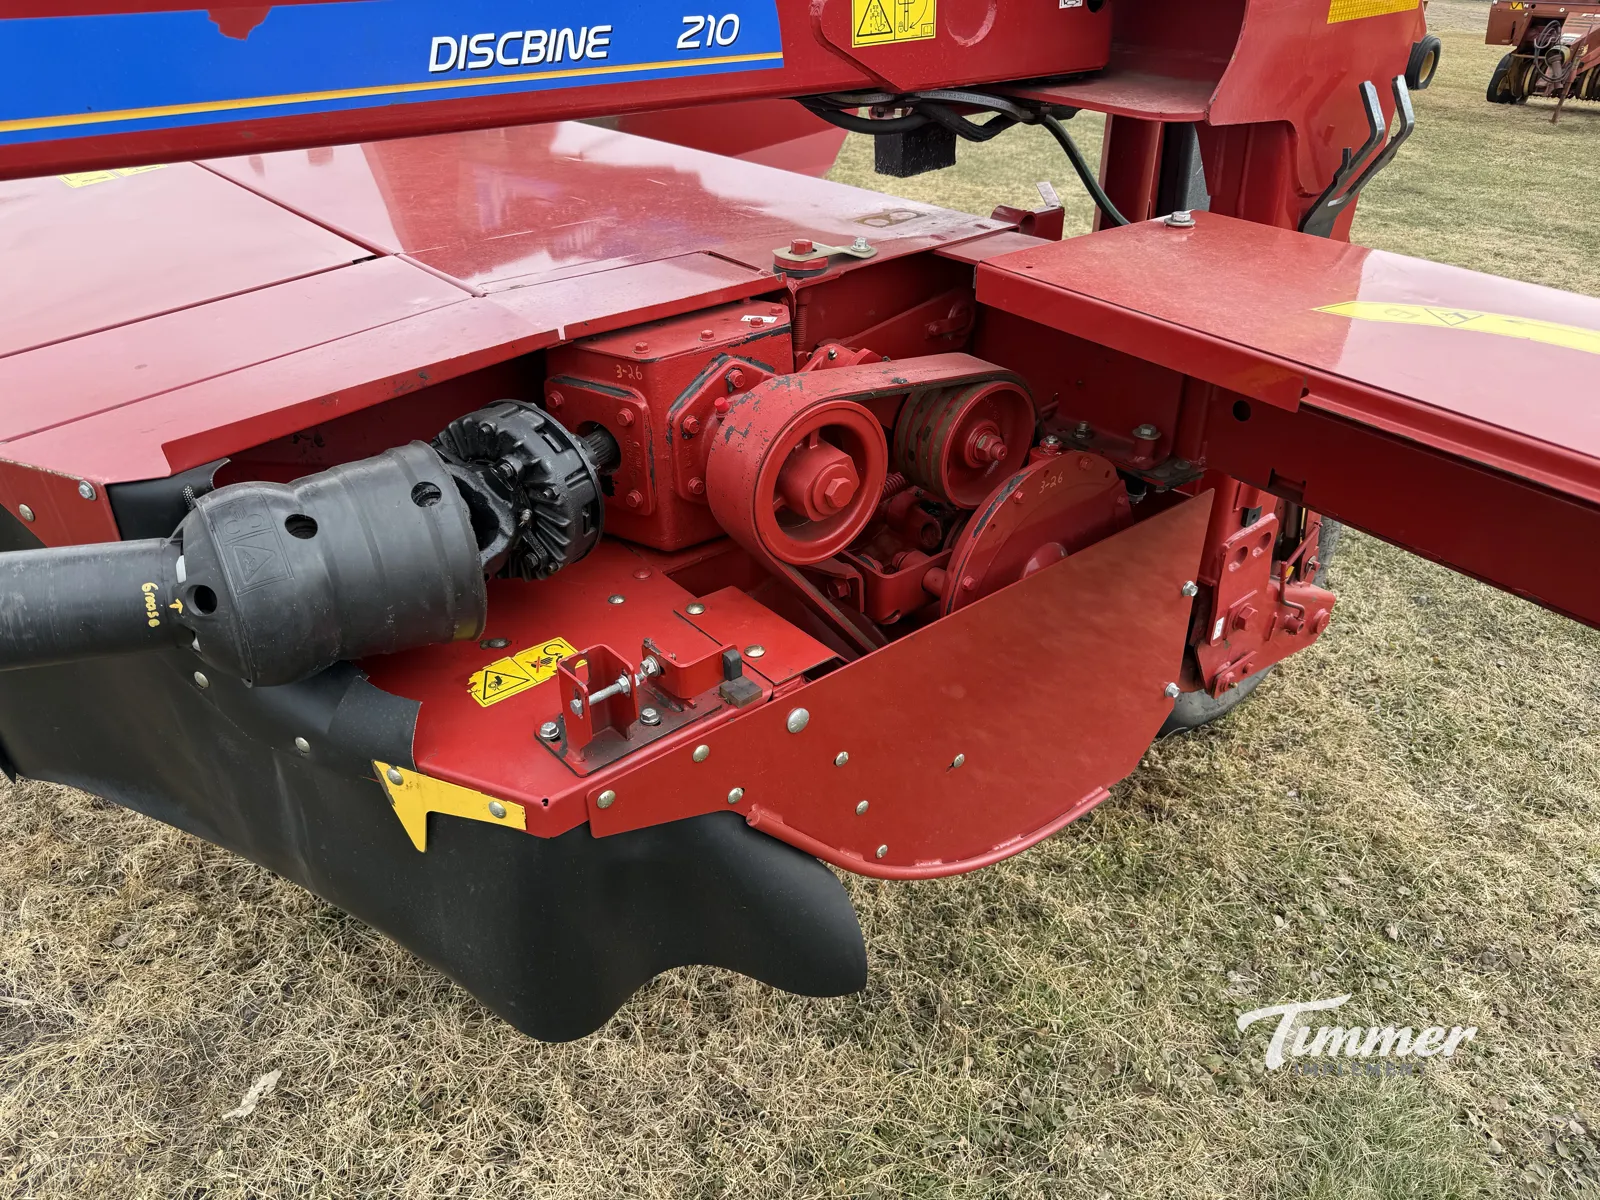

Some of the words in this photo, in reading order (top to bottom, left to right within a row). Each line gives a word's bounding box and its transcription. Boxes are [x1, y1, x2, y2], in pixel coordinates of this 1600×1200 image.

[428, 25, 612, 73] DISCBINE
[676, 13, 740, 50] 210
[615, 364, 643, 381] 3-26
[1038, 470, 1064, 495] 3-26
